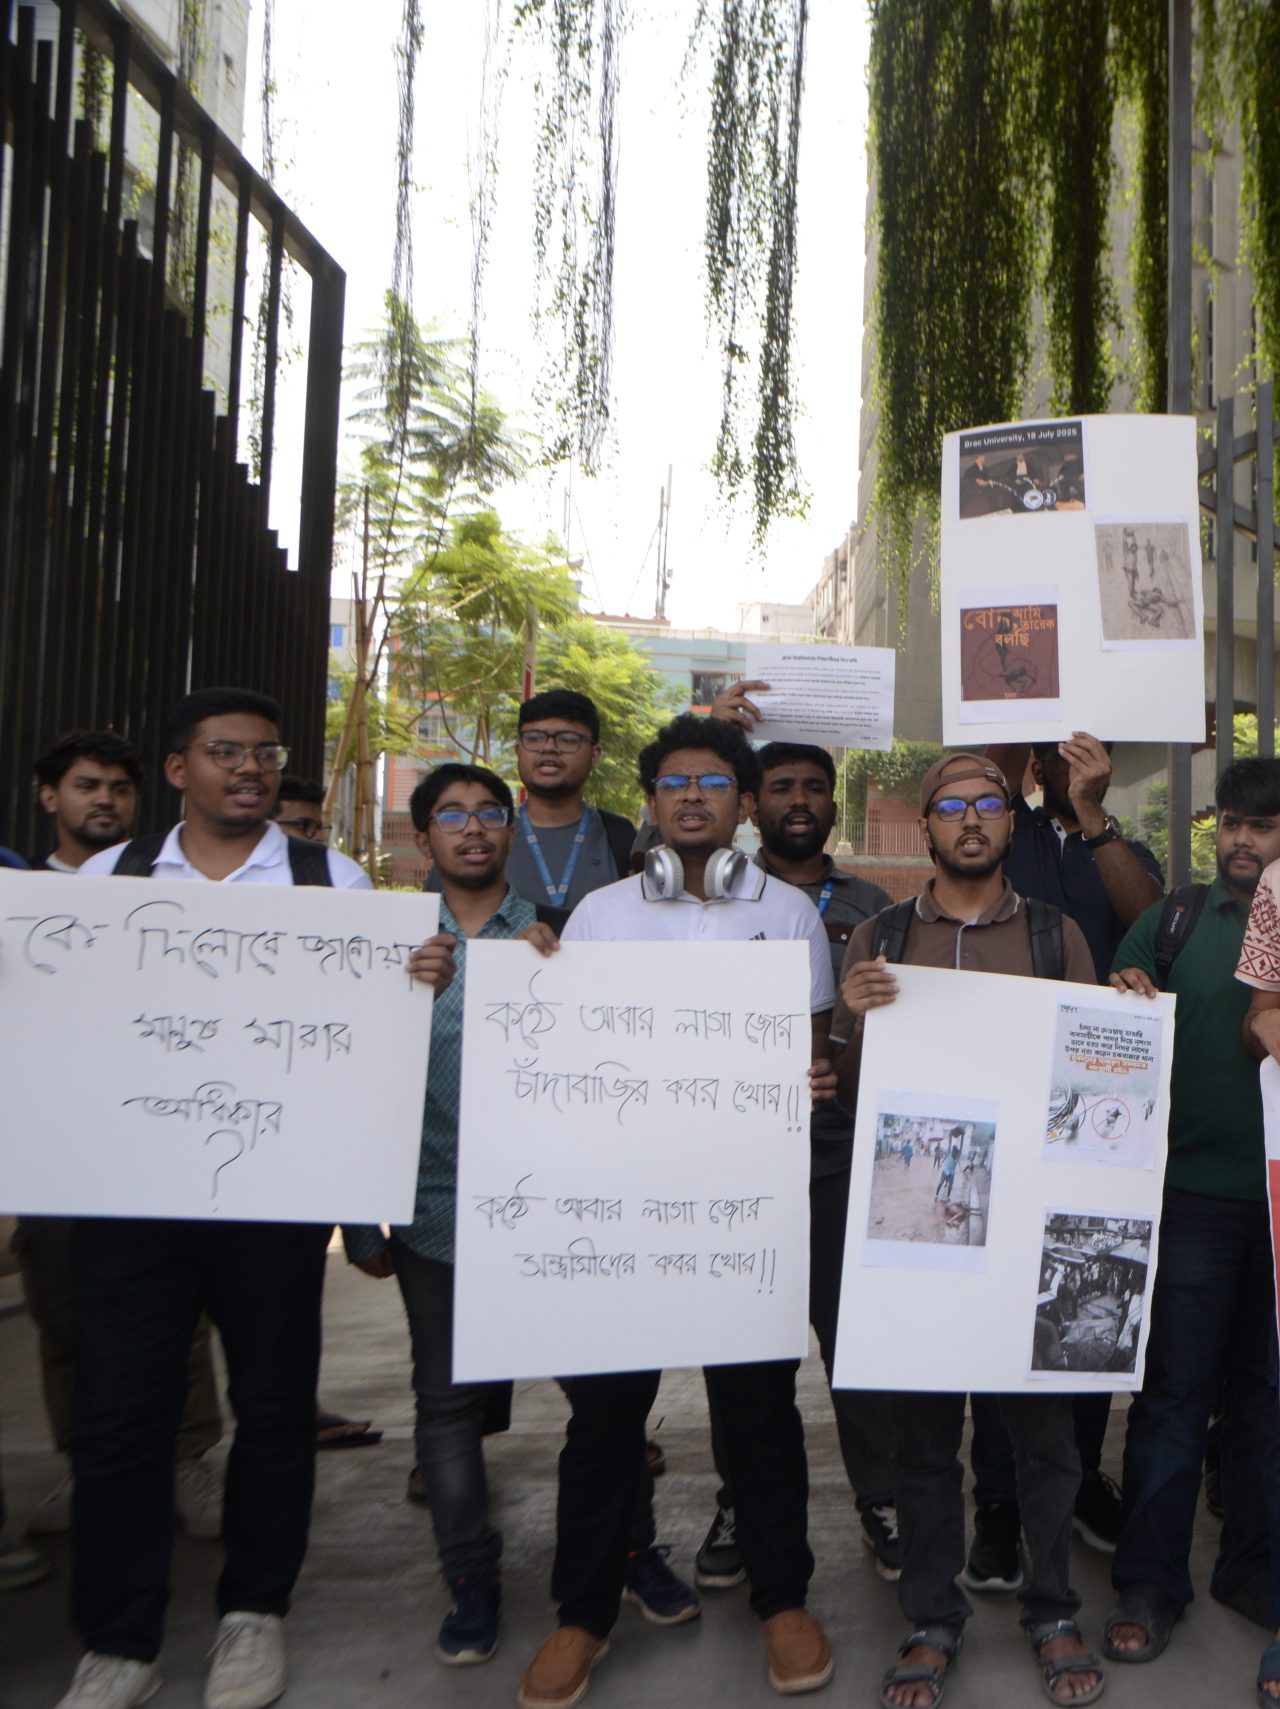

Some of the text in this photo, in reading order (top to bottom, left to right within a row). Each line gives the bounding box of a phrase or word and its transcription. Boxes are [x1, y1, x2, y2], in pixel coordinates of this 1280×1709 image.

[964, 440, 982, 449] Brac
[983, 434, 1025, 447] University,
[1038, 430, 1055, 440] July
[995, 629, 1030, 648] বলছি
[580, 1004, 654, 1039] আবার
[675, 1009, 731, 1040] লাগা
[745, 1012, 806, 1051] জোর
[243, 1017, 352, 1075] মারার
[662, 1078, 719, 1111] কবর
[642, 1199, 699, 1225] লাগা
[709, 1197, 775, 1232] জোর
[648, 1253, 696, 1276] কবর
